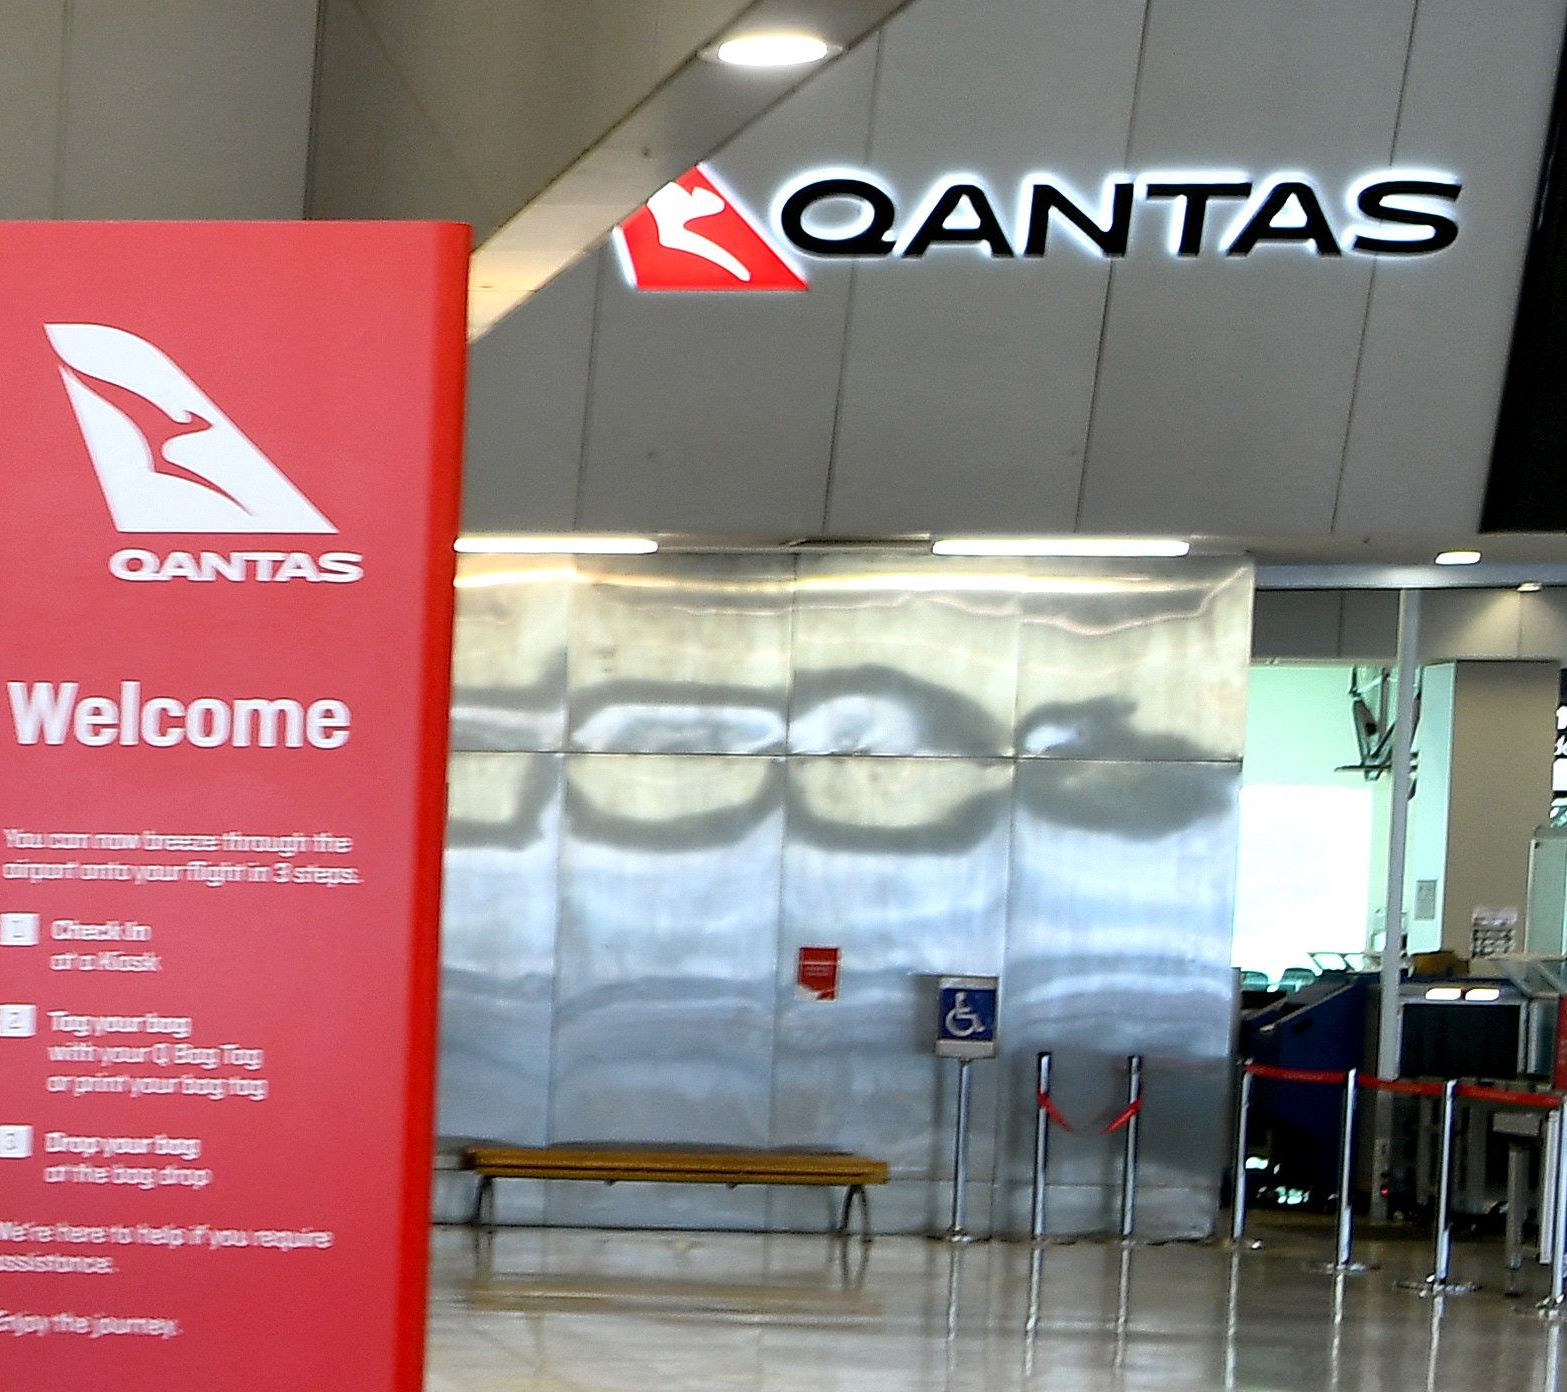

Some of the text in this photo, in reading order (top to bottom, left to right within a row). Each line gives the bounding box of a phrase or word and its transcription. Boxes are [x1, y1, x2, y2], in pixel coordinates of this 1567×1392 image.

[778, 176, 1463, 260] QANTAS
[108, 548, 365, 584] QANTAS
[6, 680, 351, 748] Welcome
[3, 828, 353, 858] You can now breeze through the
[3, 859, 79, 884] airport
[134, 866, 184, 886] your
[185, 860, 245, 887] flight
[247, 862, 271, 883] in
[273, 862, 292, 883] 3
[293, 865, 365, 888] steps.
[51, 919, 121, 940] Check
[79, 955, 97, 970] a
[98, 952, 161, 972] Kiosk
[47, 1010, 192, 1038] Tag your bag
[47, 1042, 264, 1070] with your Q Bag Tag
[47, 1073, 268, 1100] or print your bag tag
[44, 1132, 202, 1160] Drop your bag
[73, 1164, 110, 1183] the
[111, 1165, 158, 1189] bag
[158, 1166, 213, 1189] drop
[56, 1222, 108, 1243] here
[109, 1225, 134, 1244] to
[135, 1223, 185, 1249] help
[186, 1224, 210, 1245] if
[208, 1230, 249, 1250] you
[251, 1227, 334, 1252] require
[50, 1313, 91, 1334] the
